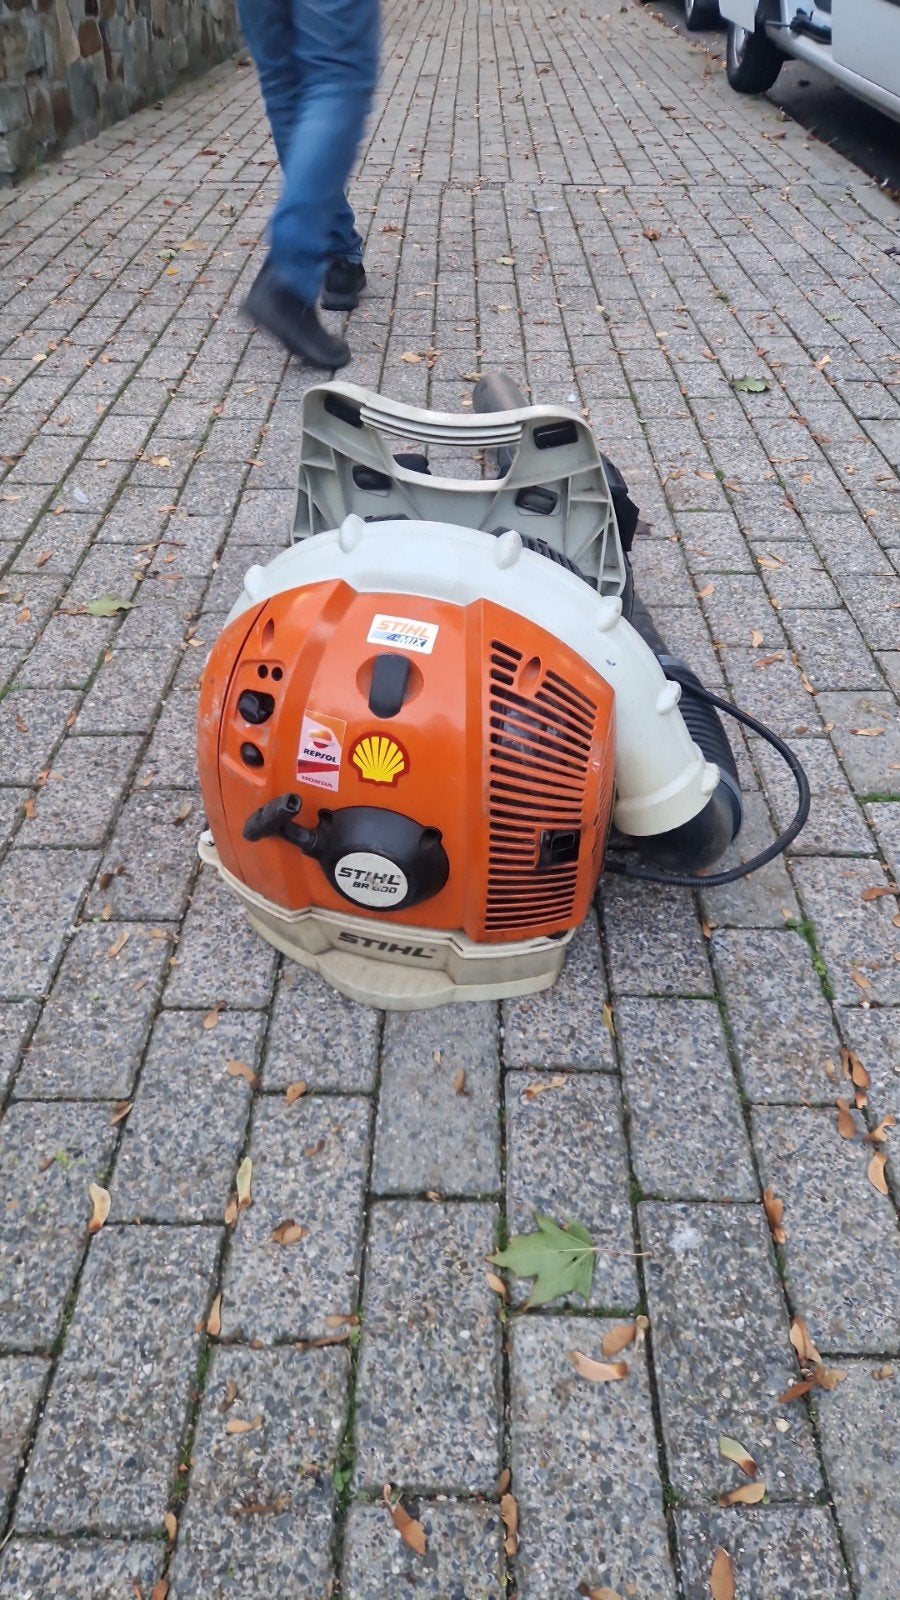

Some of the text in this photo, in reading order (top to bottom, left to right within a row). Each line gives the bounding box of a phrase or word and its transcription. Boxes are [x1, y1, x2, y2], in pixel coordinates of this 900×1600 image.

[377, 620, 429, 639] STIHL
[303, 748, 336, 763] REPSOL
[301, 775, 333, 788] HONDA
[338, 867, 400, 885] STIHL
[352, 881, 370, 890] BR
[338, 931, 433, 959] STIHL
